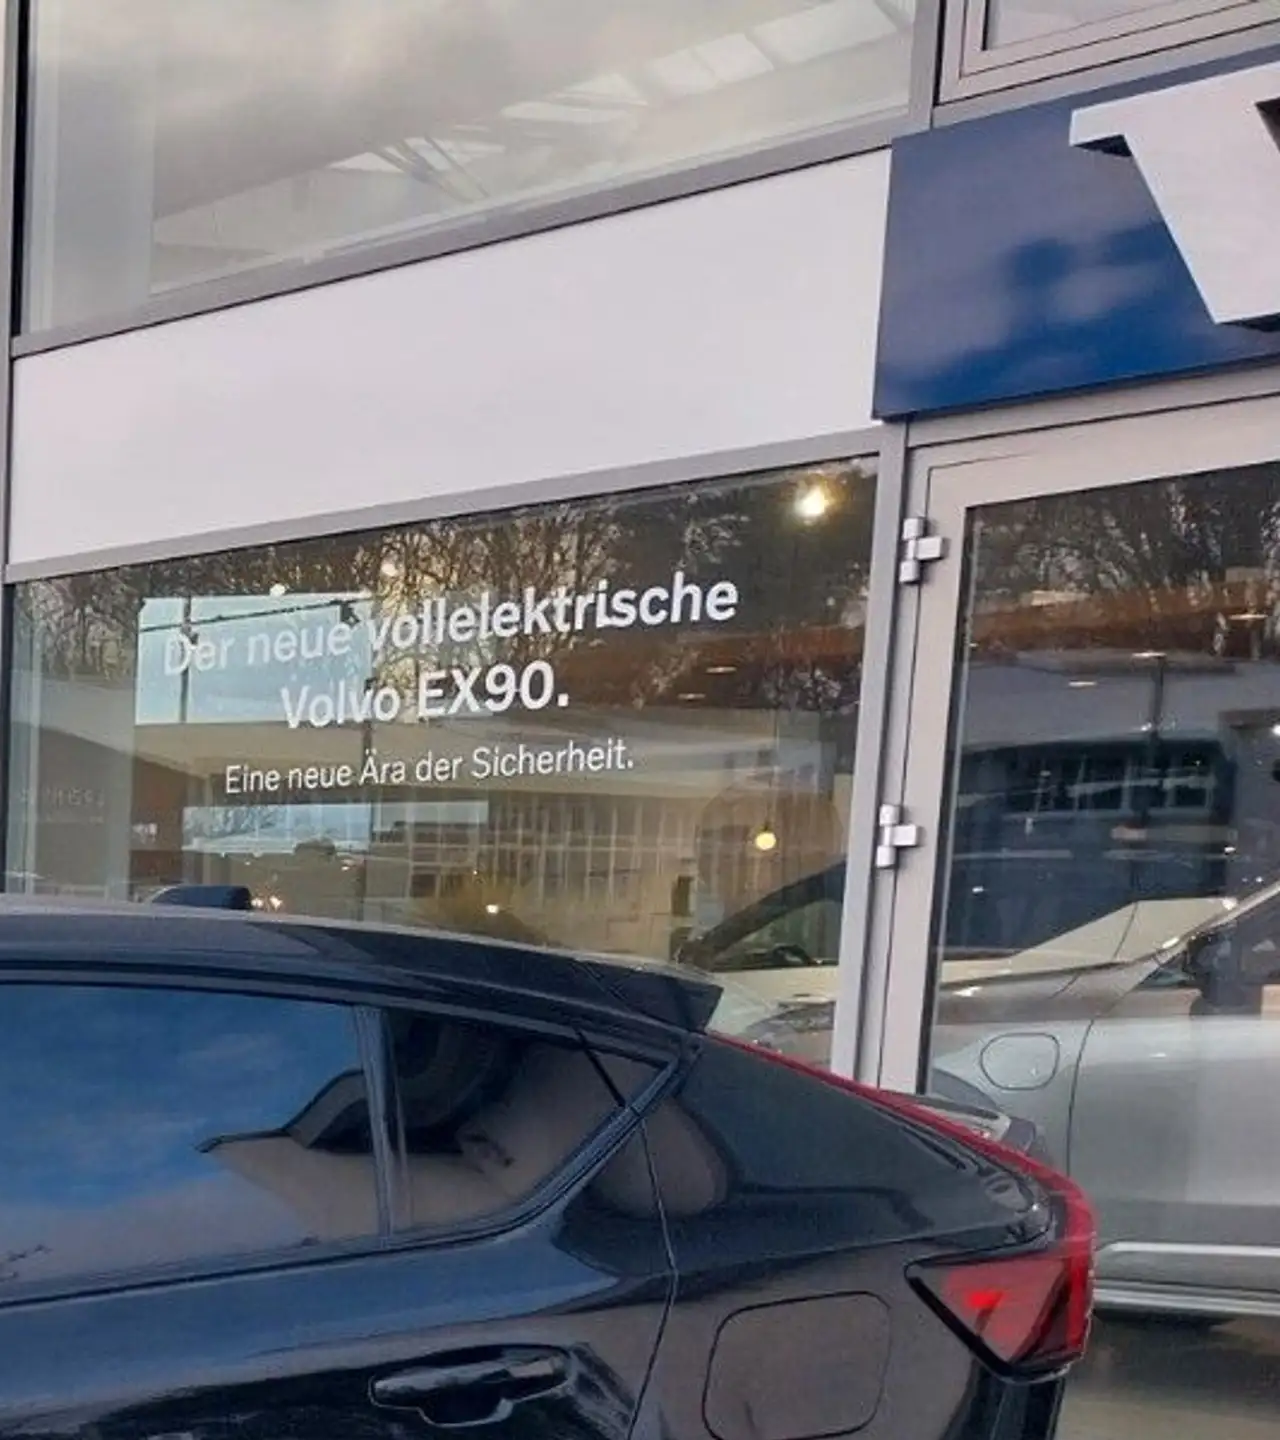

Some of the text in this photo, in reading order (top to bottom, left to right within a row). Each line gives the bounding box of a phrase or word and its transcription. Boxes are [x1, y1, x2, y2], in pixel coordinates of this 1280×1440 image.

[164, 571, 738, 676] Der neue vollelektrische
[281, 660, 568, 728] Volvo EX90.
[225, 738, 634, 794] Eine neue Ära der Sicherheit.
